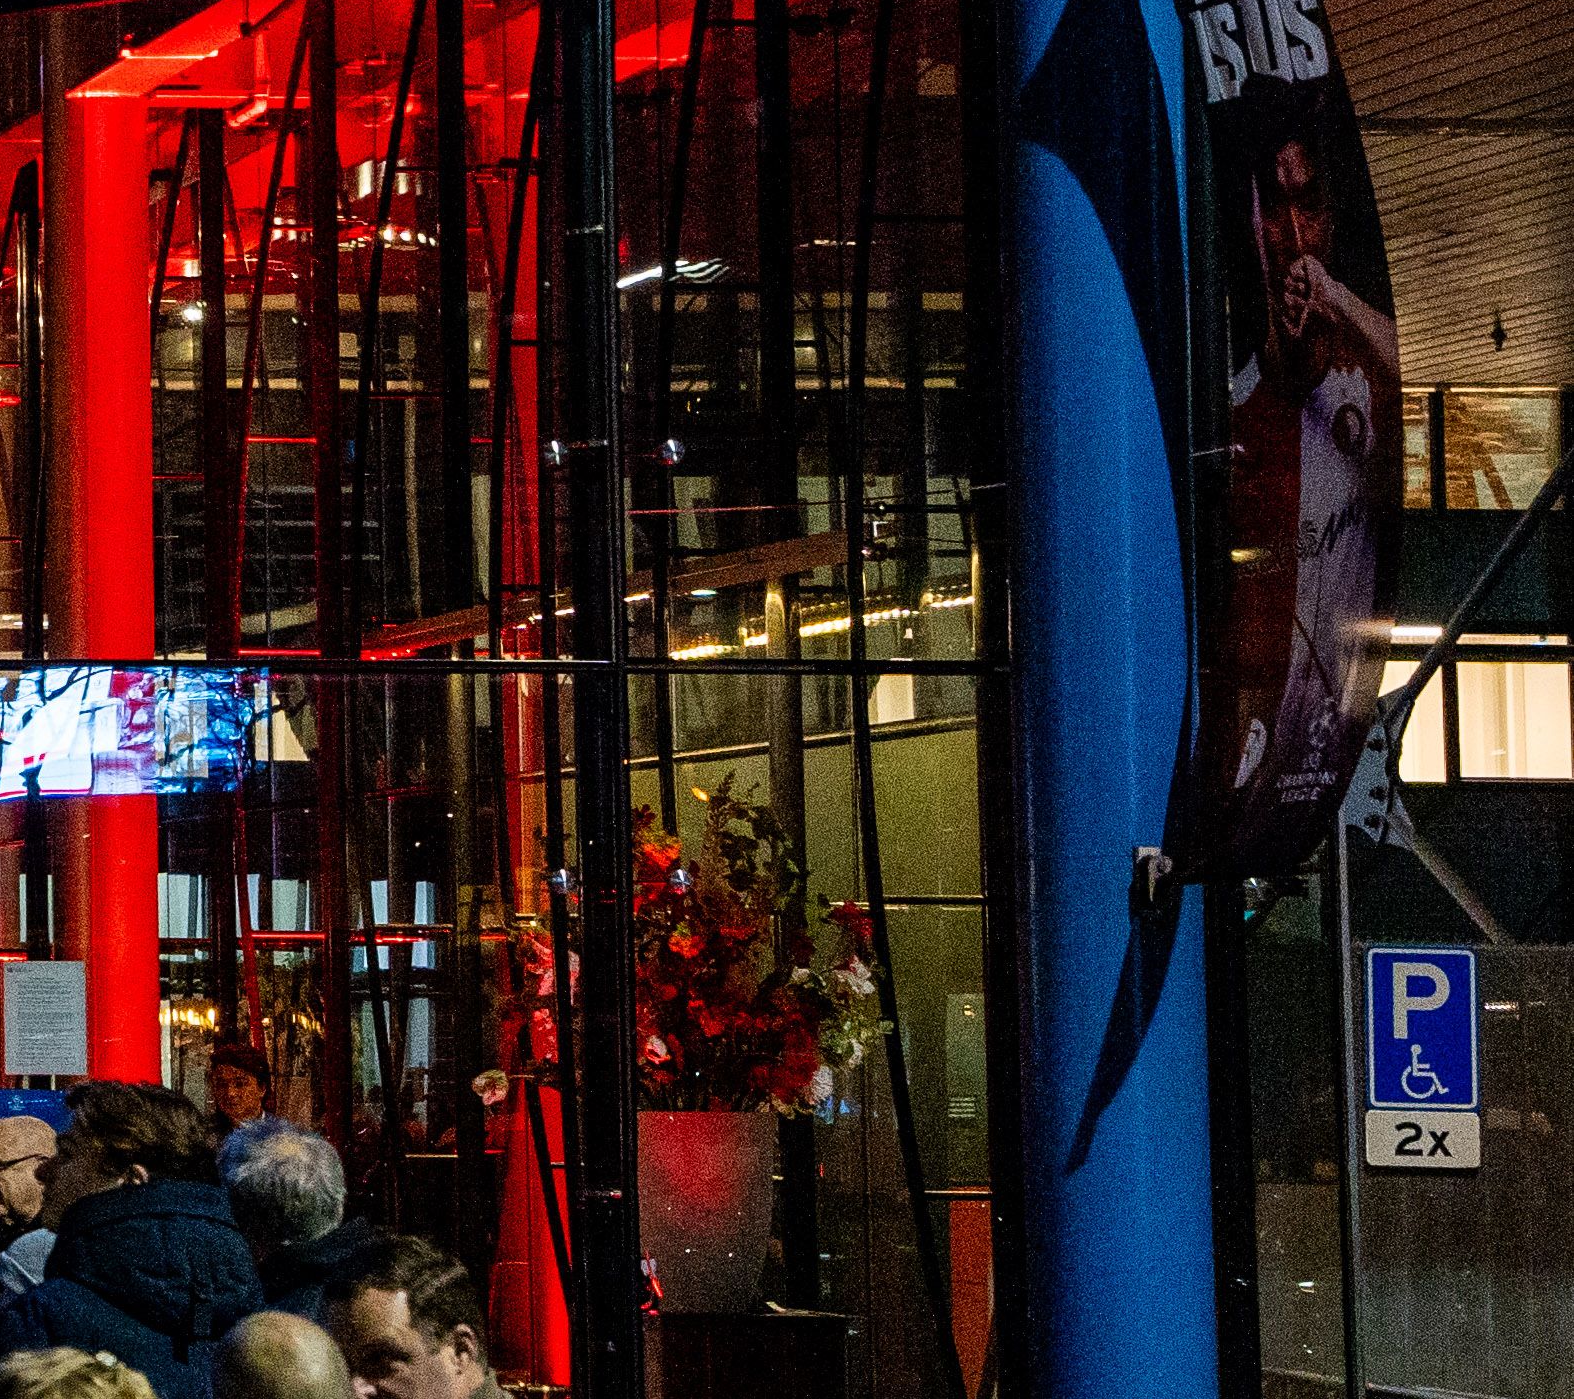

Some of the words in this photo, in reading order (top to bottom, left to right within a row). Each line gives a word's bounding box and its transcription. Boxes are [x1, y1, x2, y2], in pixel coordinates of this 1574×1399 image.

[1190, 1, 1249, 105] IS
[1393, 962, 1450, 1039] P
[1394, 1122, 1452, 1157] 2x
